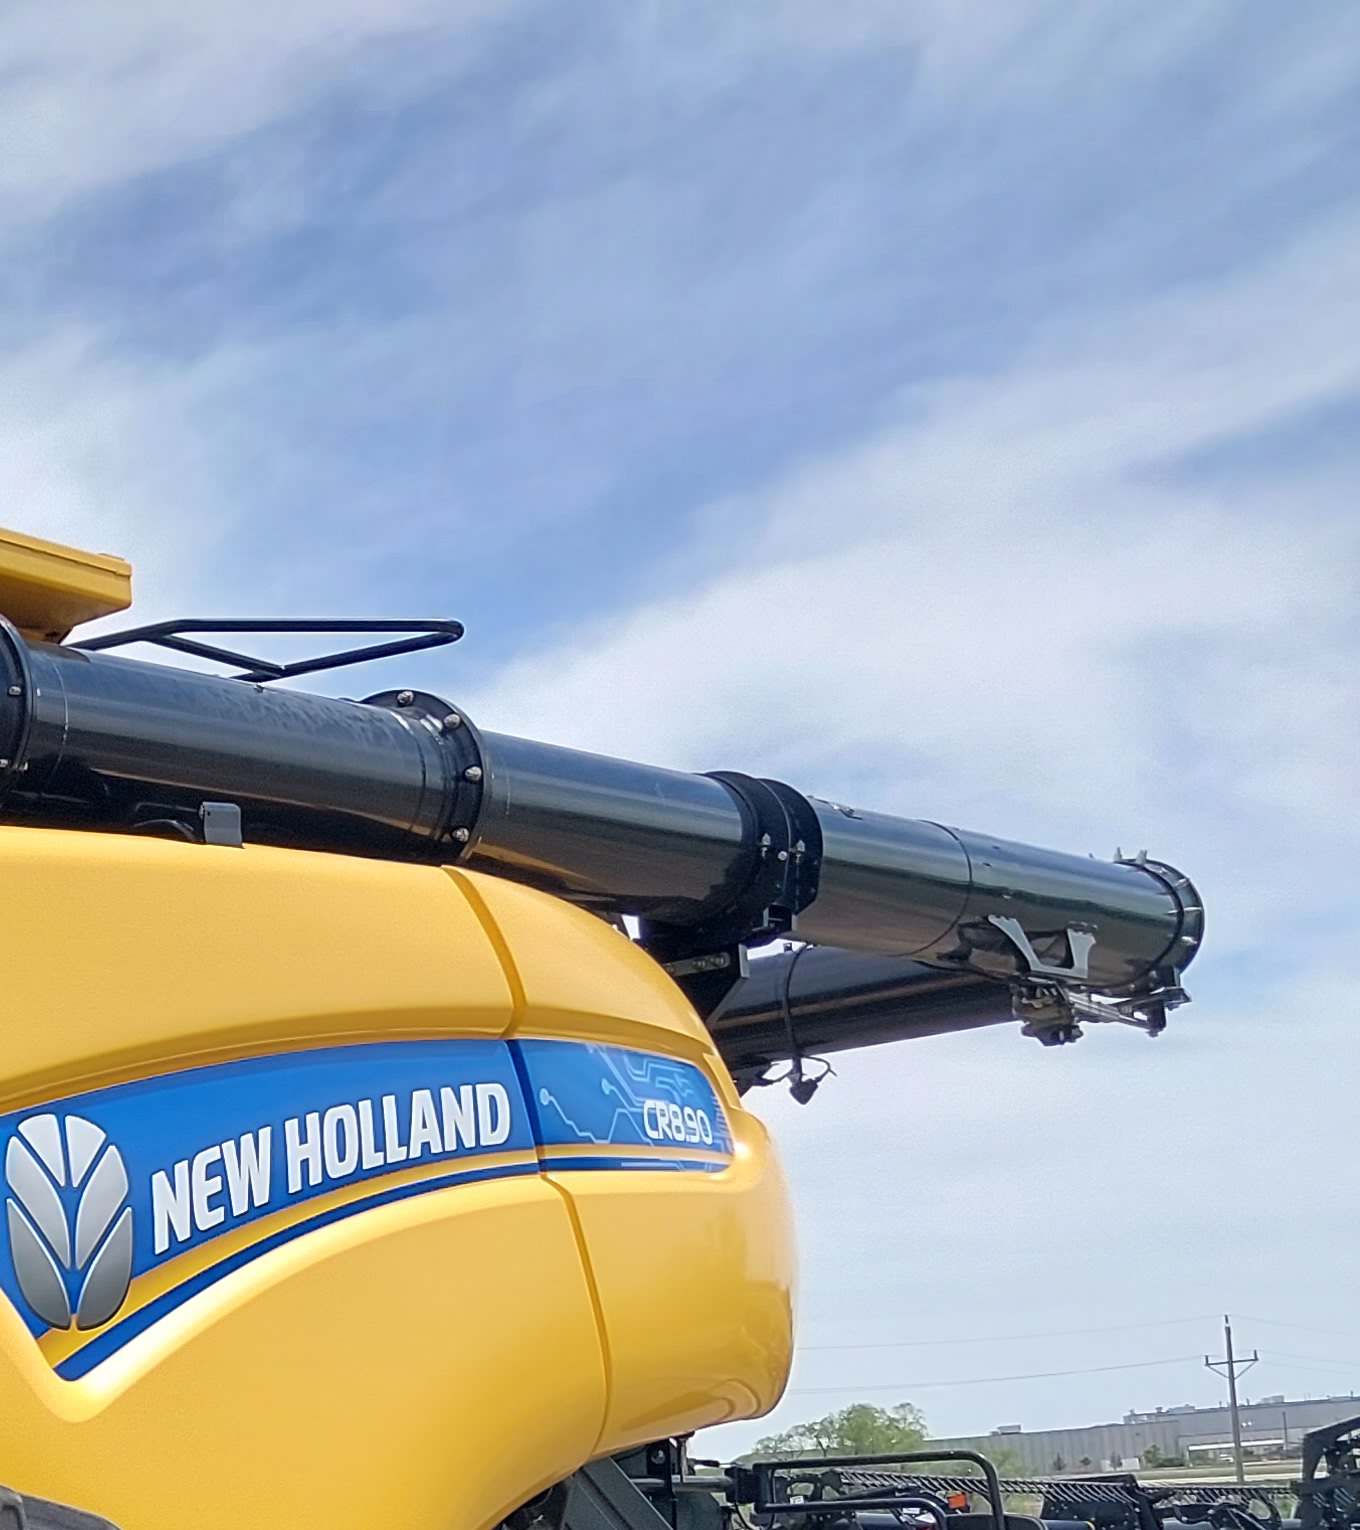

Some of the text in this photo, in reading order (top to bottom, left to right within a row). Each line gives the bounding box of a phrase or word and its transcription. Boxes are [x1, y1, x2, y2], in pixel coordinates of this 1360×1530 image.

[151, 1083, 511, 1256] NEW HOLLAND
[643, 1100, 713, 1146] CR8.90
